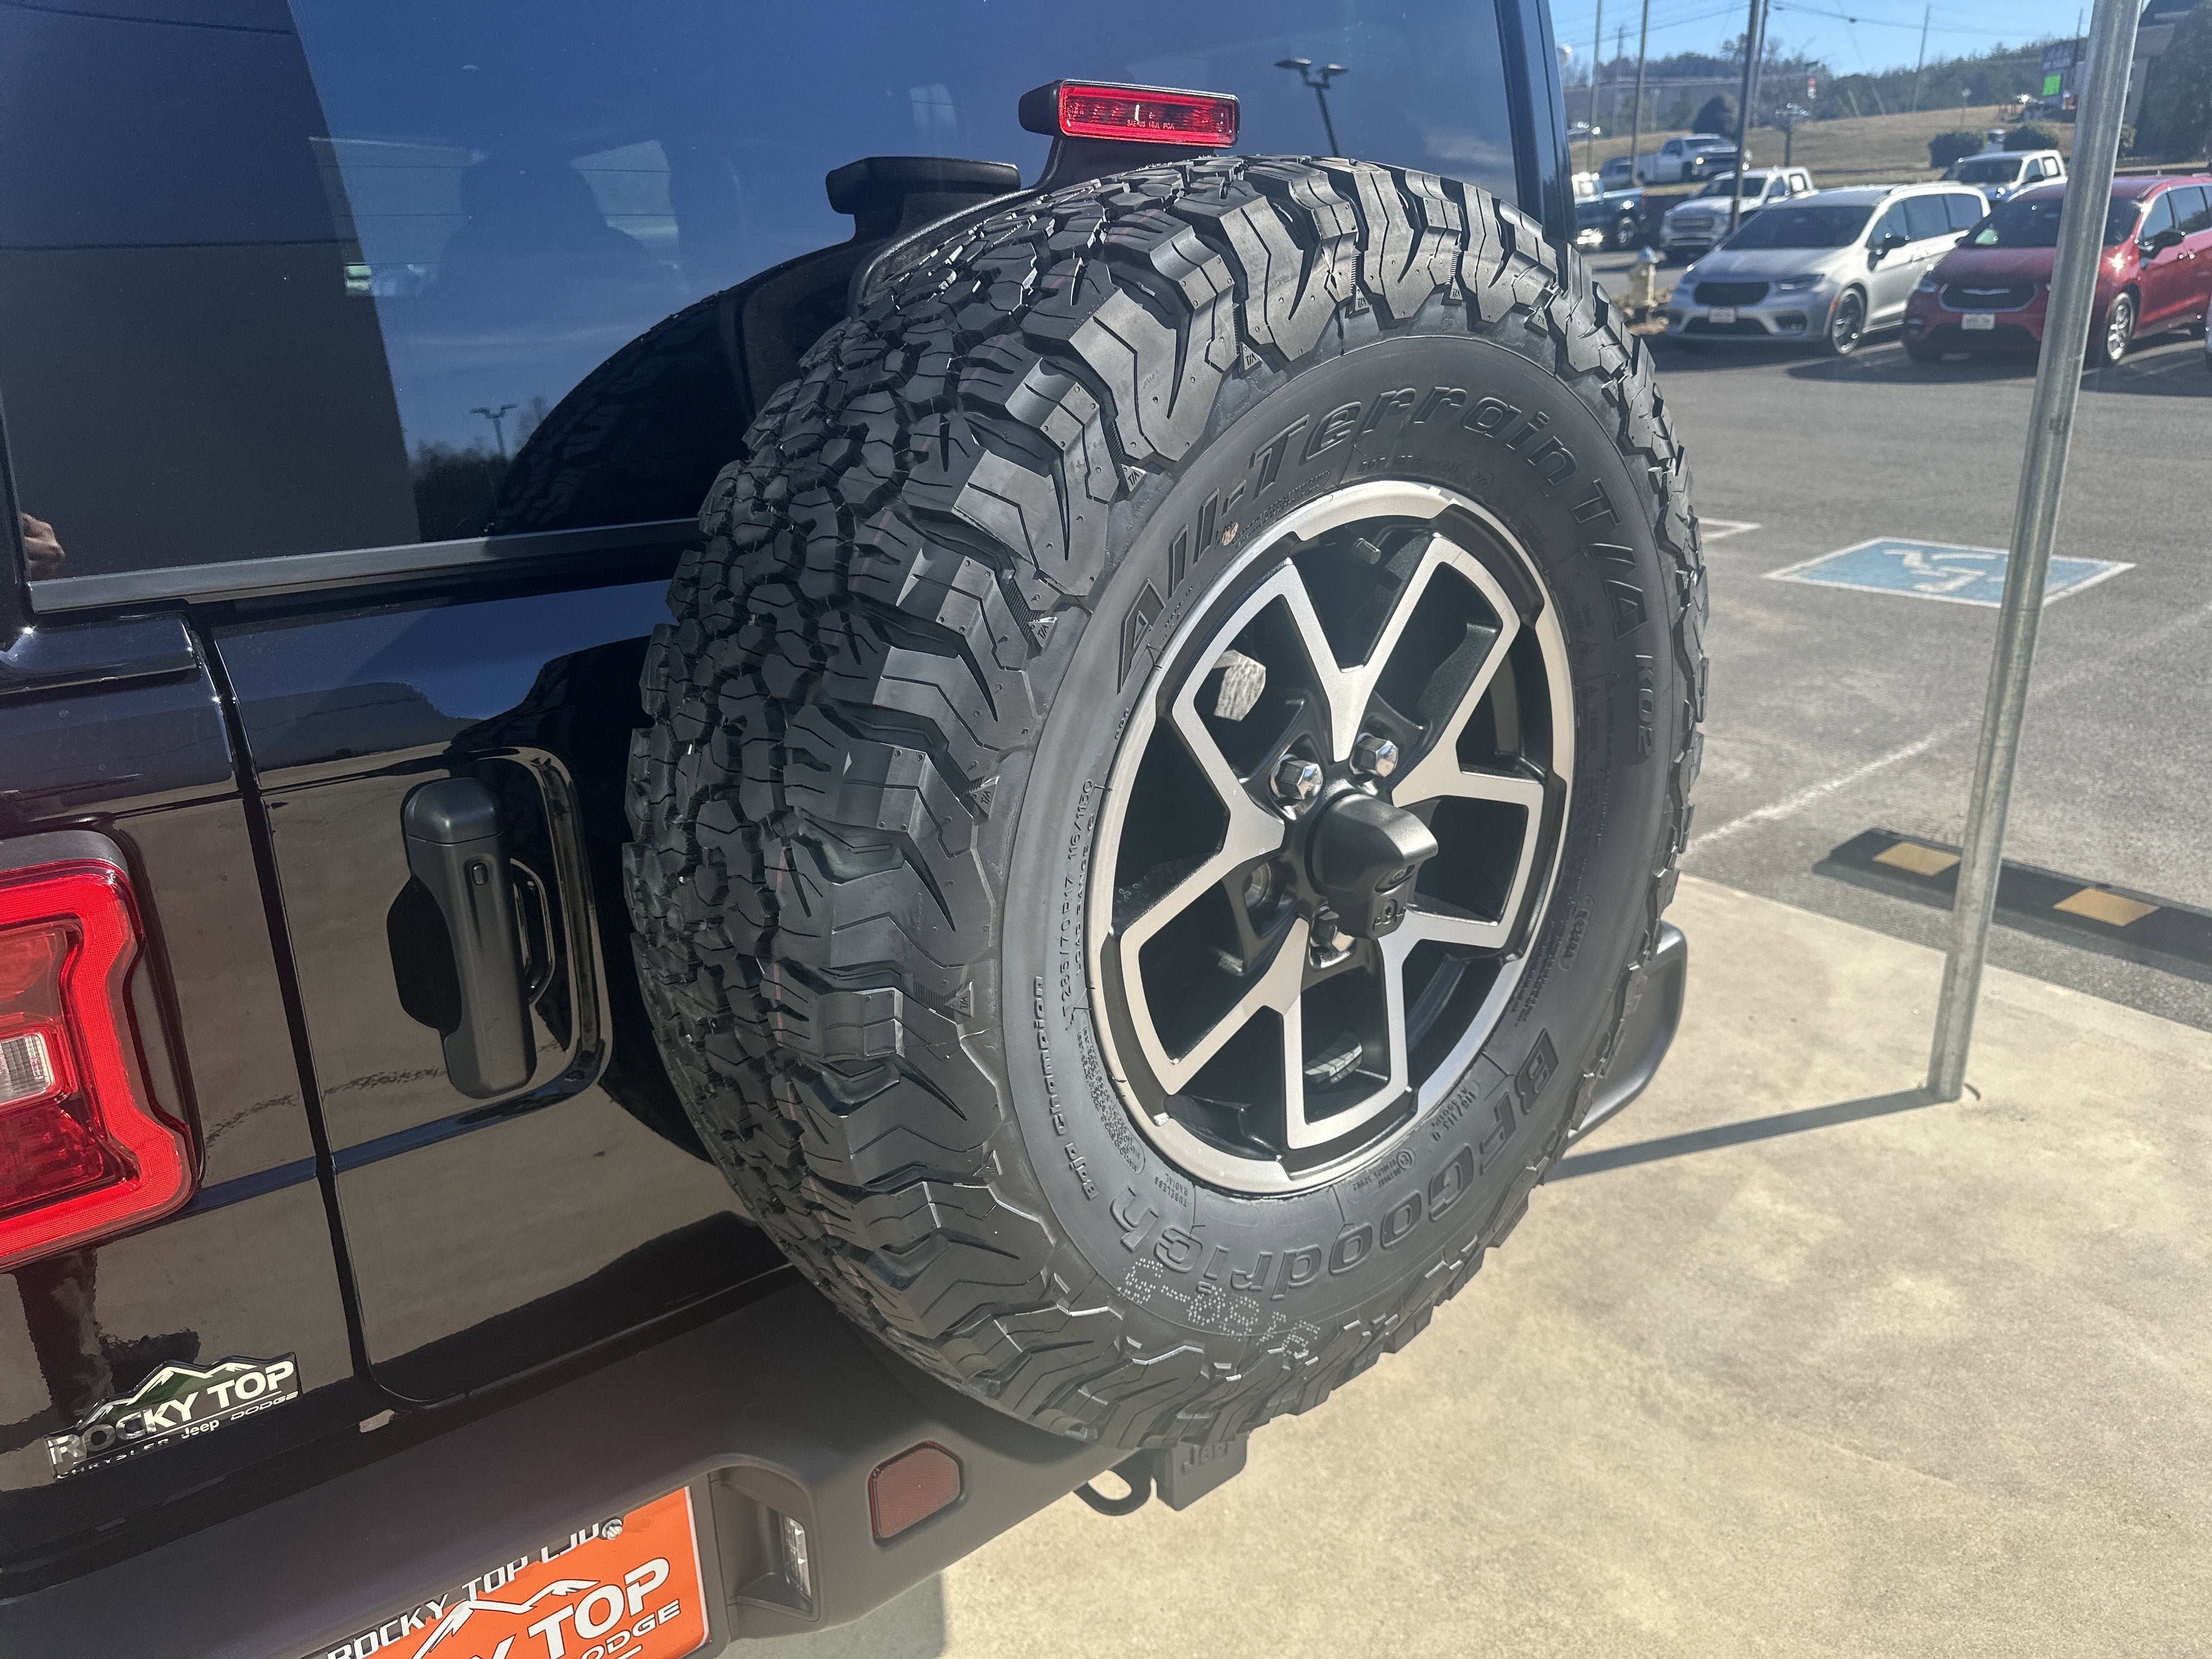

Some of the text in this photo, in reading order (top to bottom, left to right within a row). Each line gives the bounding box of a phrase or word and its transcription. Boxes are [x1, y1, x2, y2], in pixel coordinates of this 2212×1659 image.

[1356, 297, 1367, 308] T/A
[1245, 353, 1256, 366] T/A
[1126, 471, 1136, 486] T/A
[1117, 385, 1578, 695] All-Terrain
[1571, 478, 1646, 640] T/A
[1037, 624, 1049, 639] T/A
[980, 791, 991, 805] T/A
[960, 996, 968, 1010] T/A
[1032, 975, 1068, 1136] Champion
[1064, 1142, 1099, 1202] Baja
[1109, 1028, 1559, 1301] BFGoodrich
[1154, 1176, 1188, 1207] TUBELESS
[1165, 1172, 1189, 1197] RADIAL
[48, 1360, 295, 1465] ROCKY TOP
[57, 1390, 298, 1480] CHRYSLER Jeep DODGE
[326, 1594, 449, 1659] ROCKY
[462, 1555, 529, 1602] TOP
[528, 1556, 670, 1659] TOP
[580, 1599, 681, 1659] ODGE
